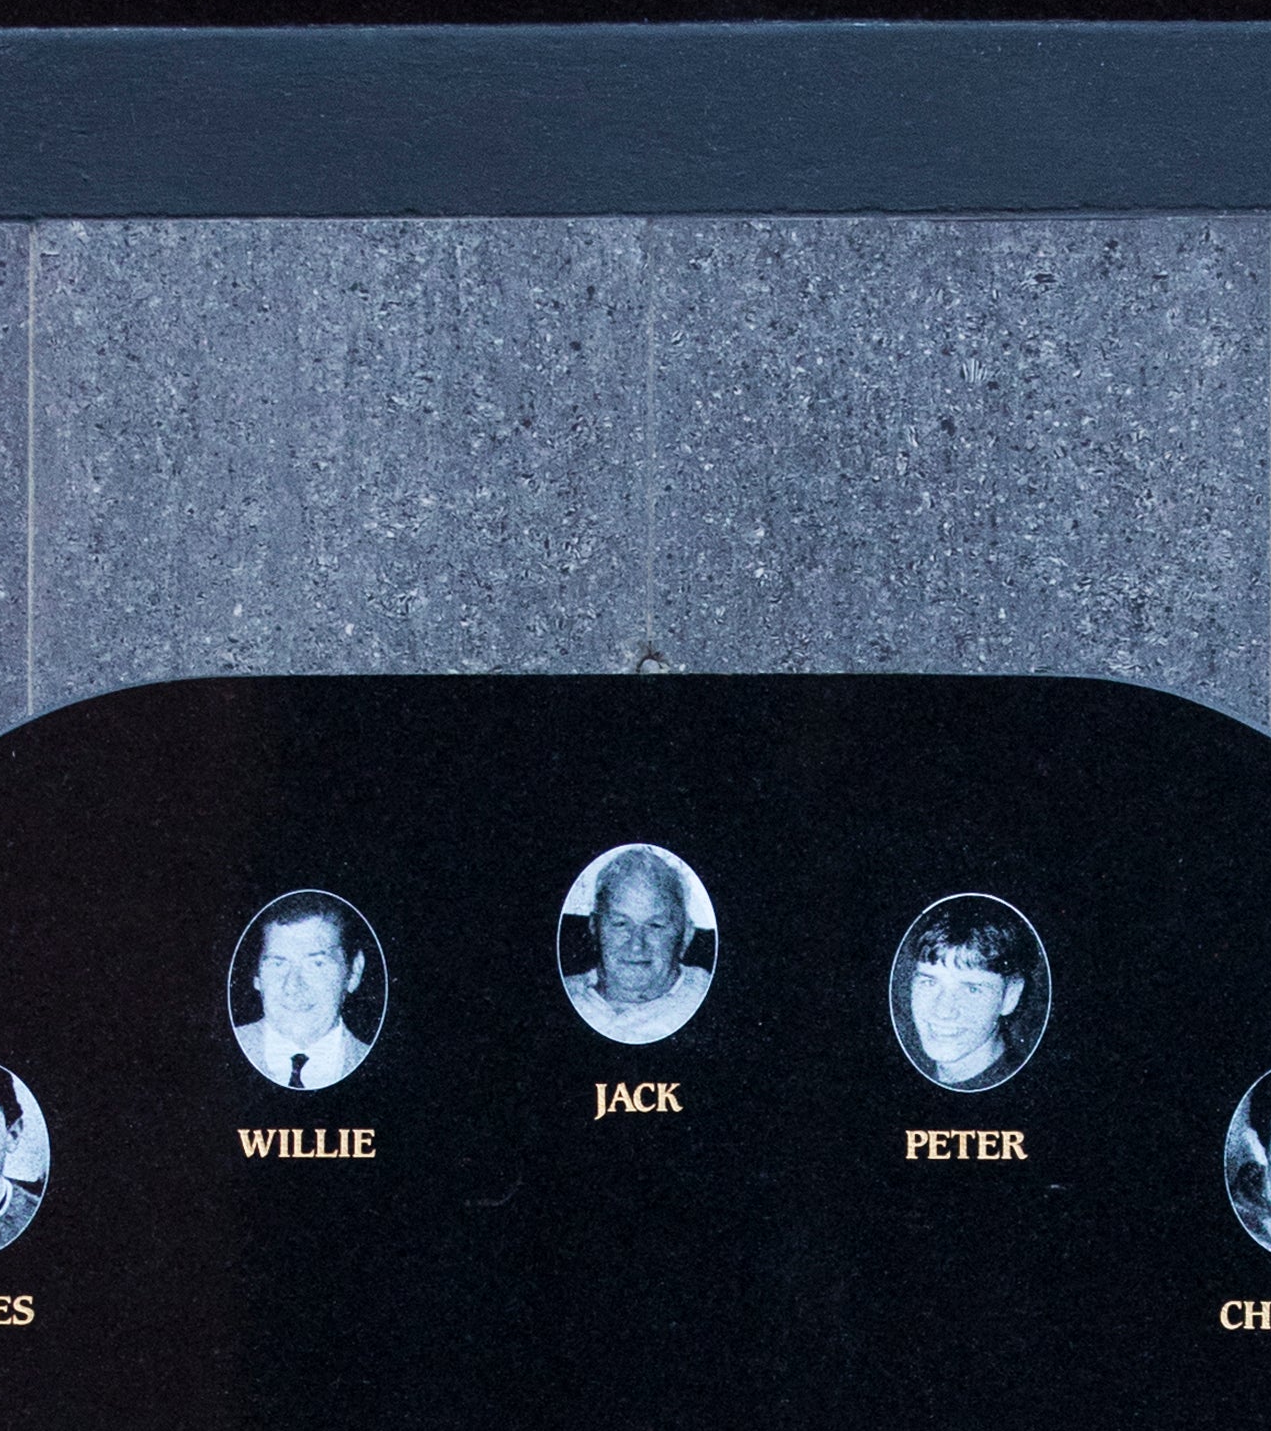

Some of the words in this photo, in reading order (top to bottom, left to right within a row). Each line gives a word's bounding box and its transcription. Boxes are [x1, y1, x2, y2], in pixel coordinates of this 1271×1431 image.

[595, 1083, 683, 1120] JACK
[238, 1129, 376, 1158] WILLIE
[906, 1130, 1028, 1159] PETER
